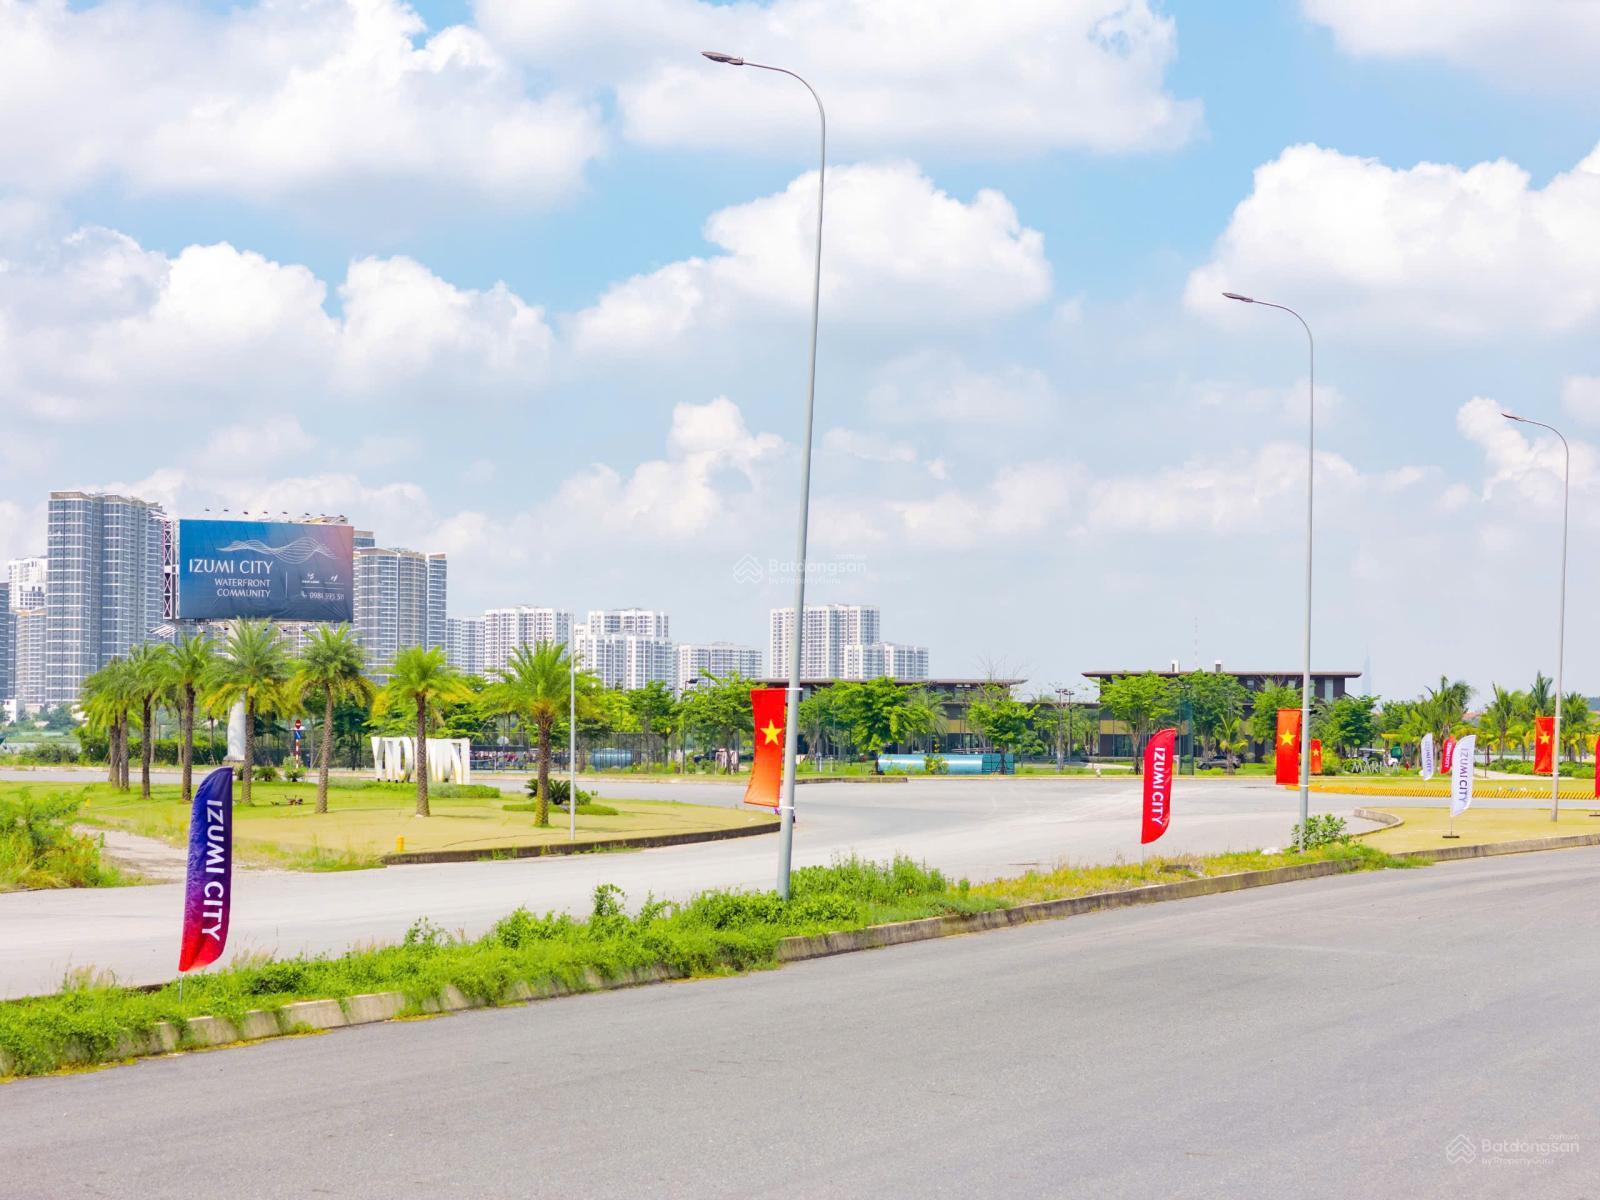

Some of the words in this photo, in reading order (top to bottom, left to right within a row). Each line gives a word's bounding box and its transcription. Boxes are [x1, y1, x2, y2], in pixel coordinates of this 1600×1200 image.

[189, 559, 233, 574] IZUMI
[239, 560, 273, 574] CITY
[214, 578, 271, 588] WATERFRONT
[216, 589, 271, 598] COMMUNITY
[1152, 748, 1165, 789] IZUMI
[1352, 761, 1399, 773] MARIA
[1459, 748, 1468, 778] IZUMI
[1459, 779, 1468, 803] CITY
[1151, 791, 1164, 825] CITY
[206, 800, 225, 873] IZUMI
[202, 881, 224, 941] CITY
